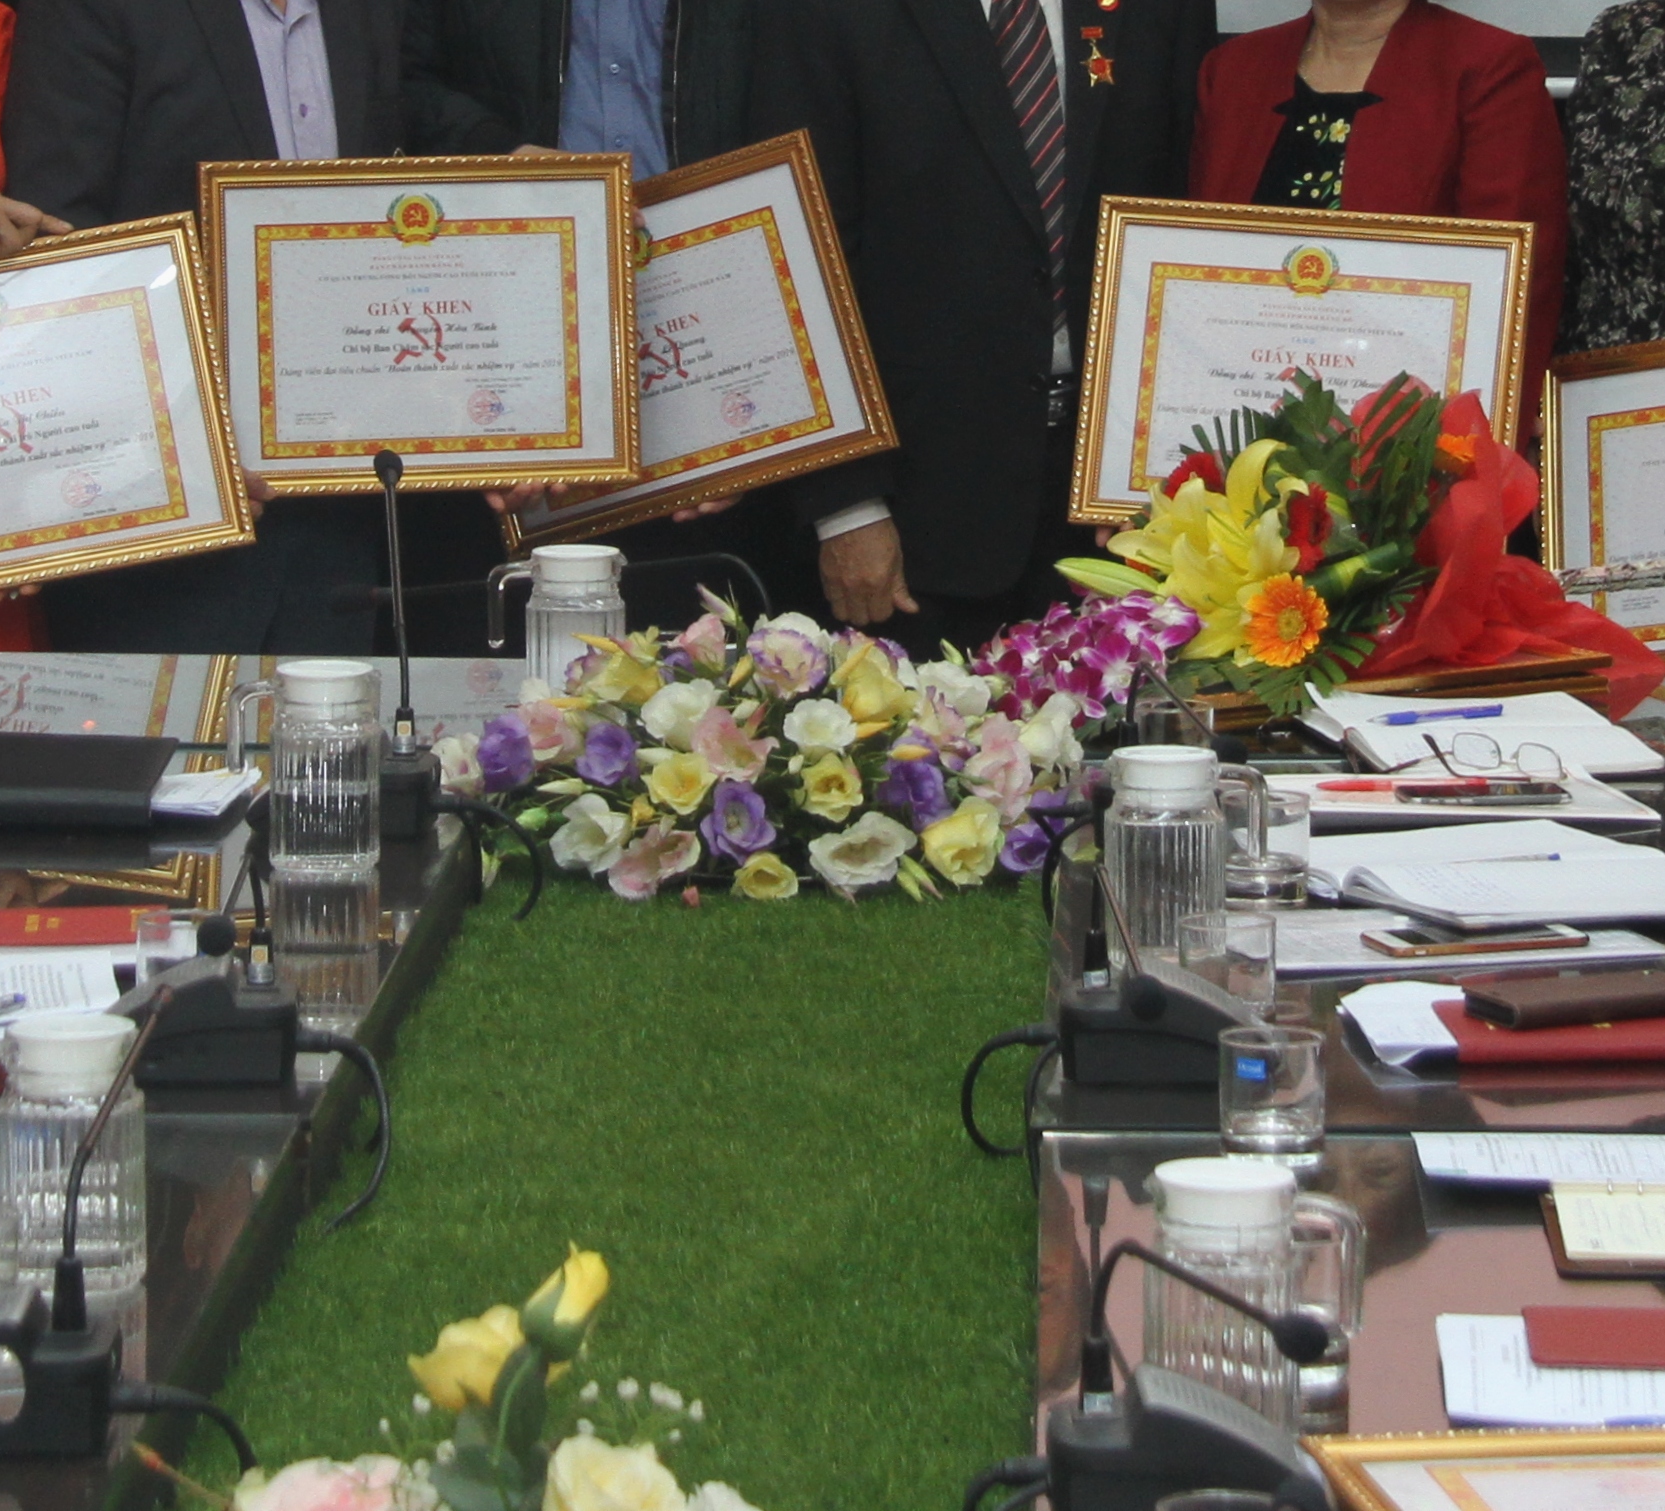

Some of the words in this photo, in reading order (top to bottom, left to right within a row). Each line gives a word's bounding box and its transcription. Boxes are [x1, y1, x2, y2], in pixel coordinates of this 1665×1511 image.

[367, 296, 414, 318] GIẤY
[422, 299, 474, 316] KHEN
[654, 312, 701, 338] KHEN
[1250, 345, 1296, 366] GIẤY
[1305, 353, 1356, 369] KHEN
[0, 385, 54, 409] KHEN
